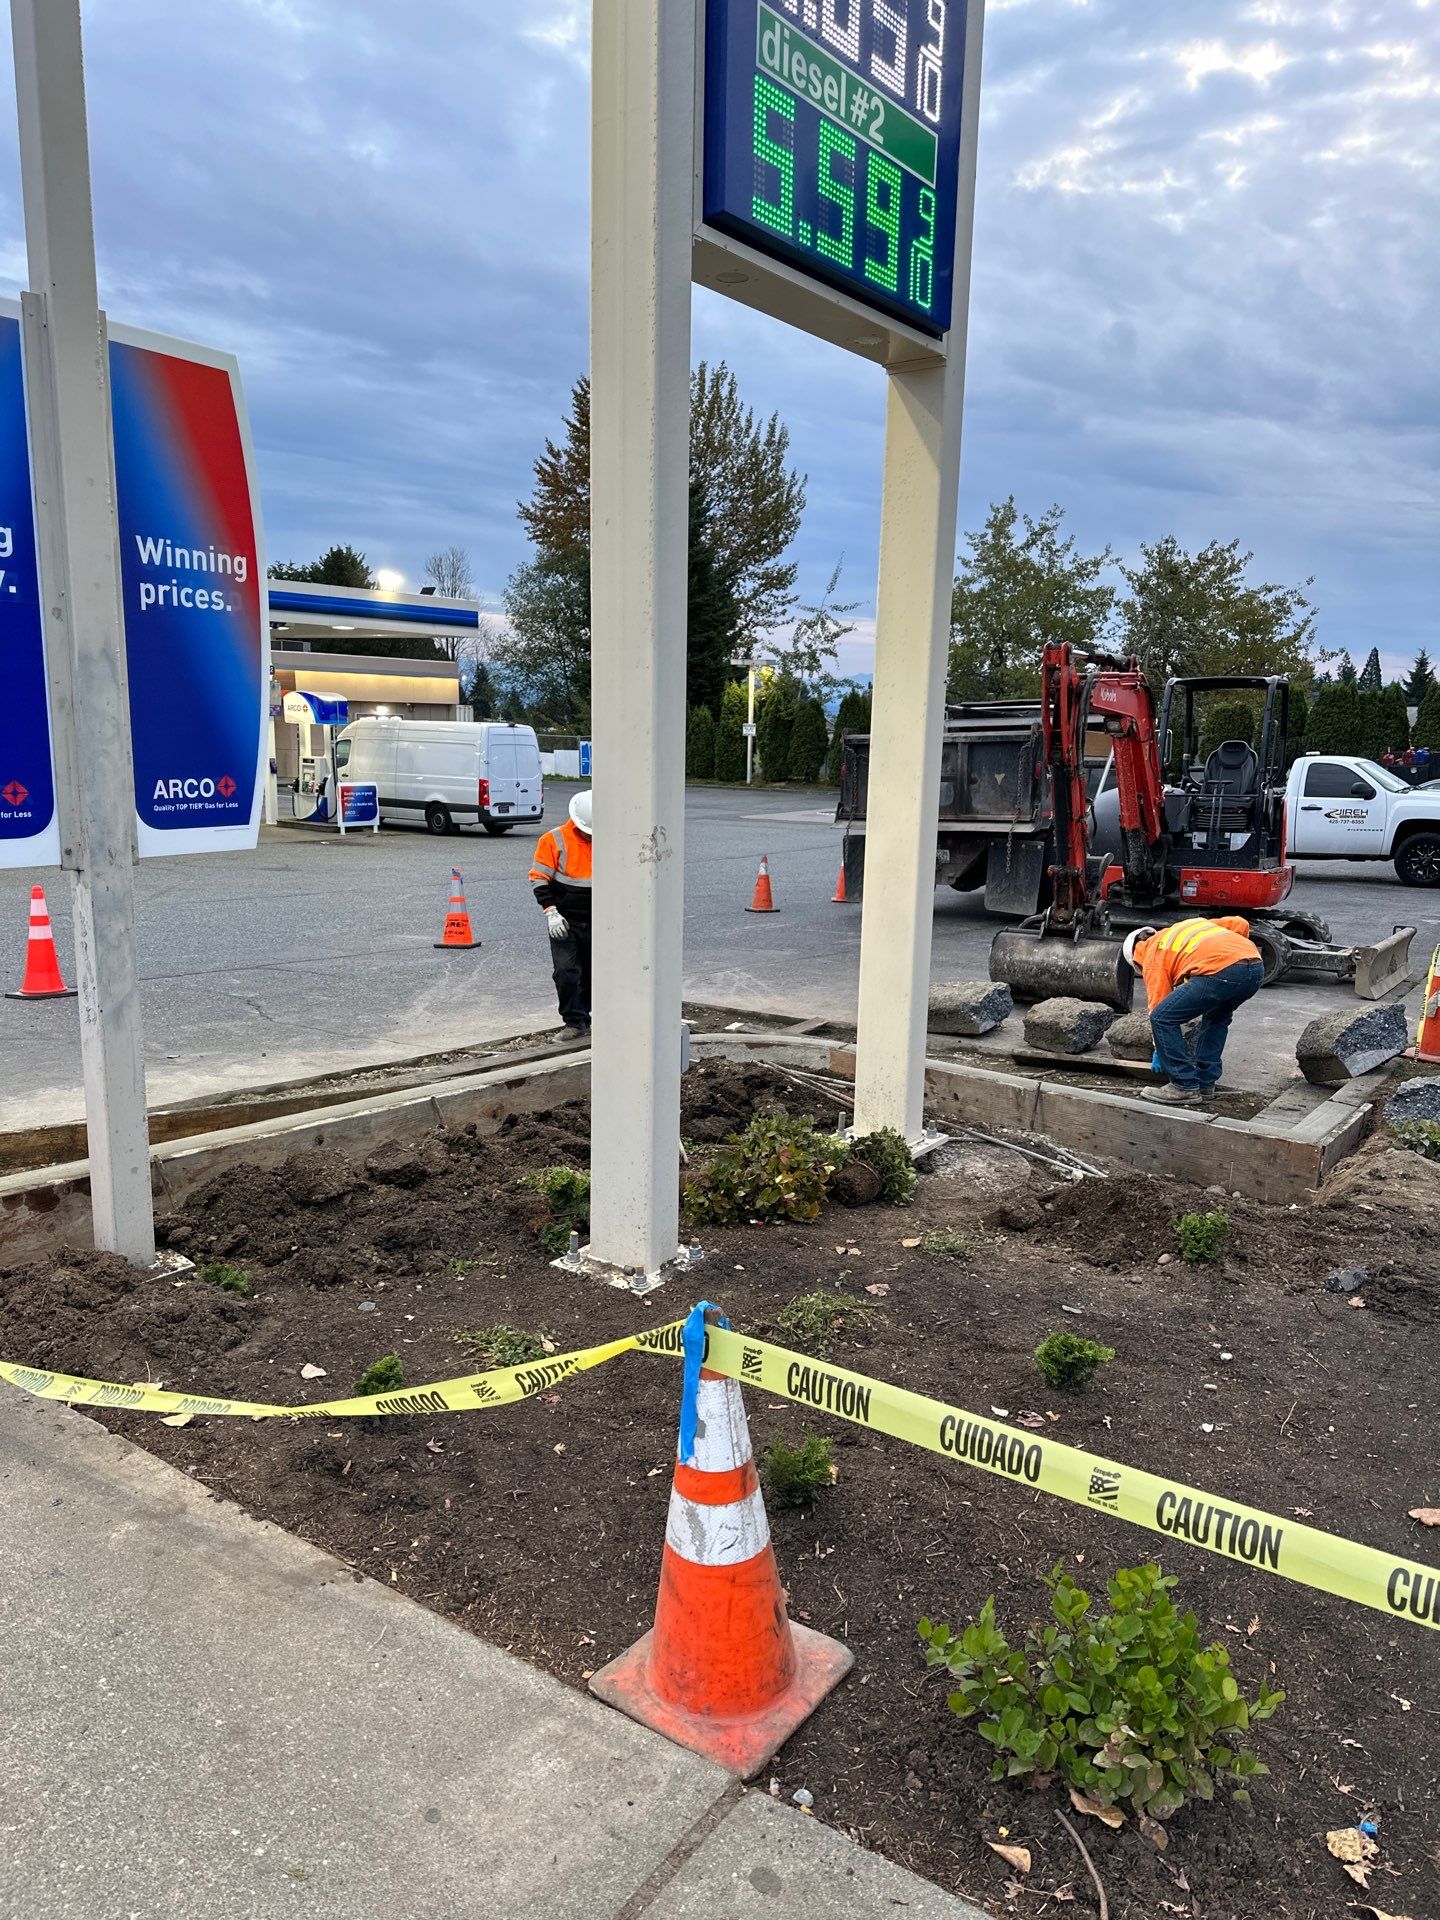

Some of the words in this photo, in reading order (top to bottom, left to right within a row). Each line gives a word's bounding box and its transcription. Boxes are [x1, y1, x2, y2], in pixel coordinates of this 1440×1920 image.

[752, 74, 901, 293] 5.59
[135, 534, 247, 583] Winning
[140, 578, 232, 612] prices.
[287, 704, 302, 712] ARCO
[153, 777, 215, 800] ARCO
[0, 811, 13, 819] for
[153, 804, 176, 812] Quality
[176, 803, 188, 811] TOP
[1336, 808, 1369, 816] JIREH
[787, 1361, 872, 1422] CAUTION
[939, 1414, 1043, 1483] CUIDADO
[1155, 1490, 1284, 1570] CAUTION
